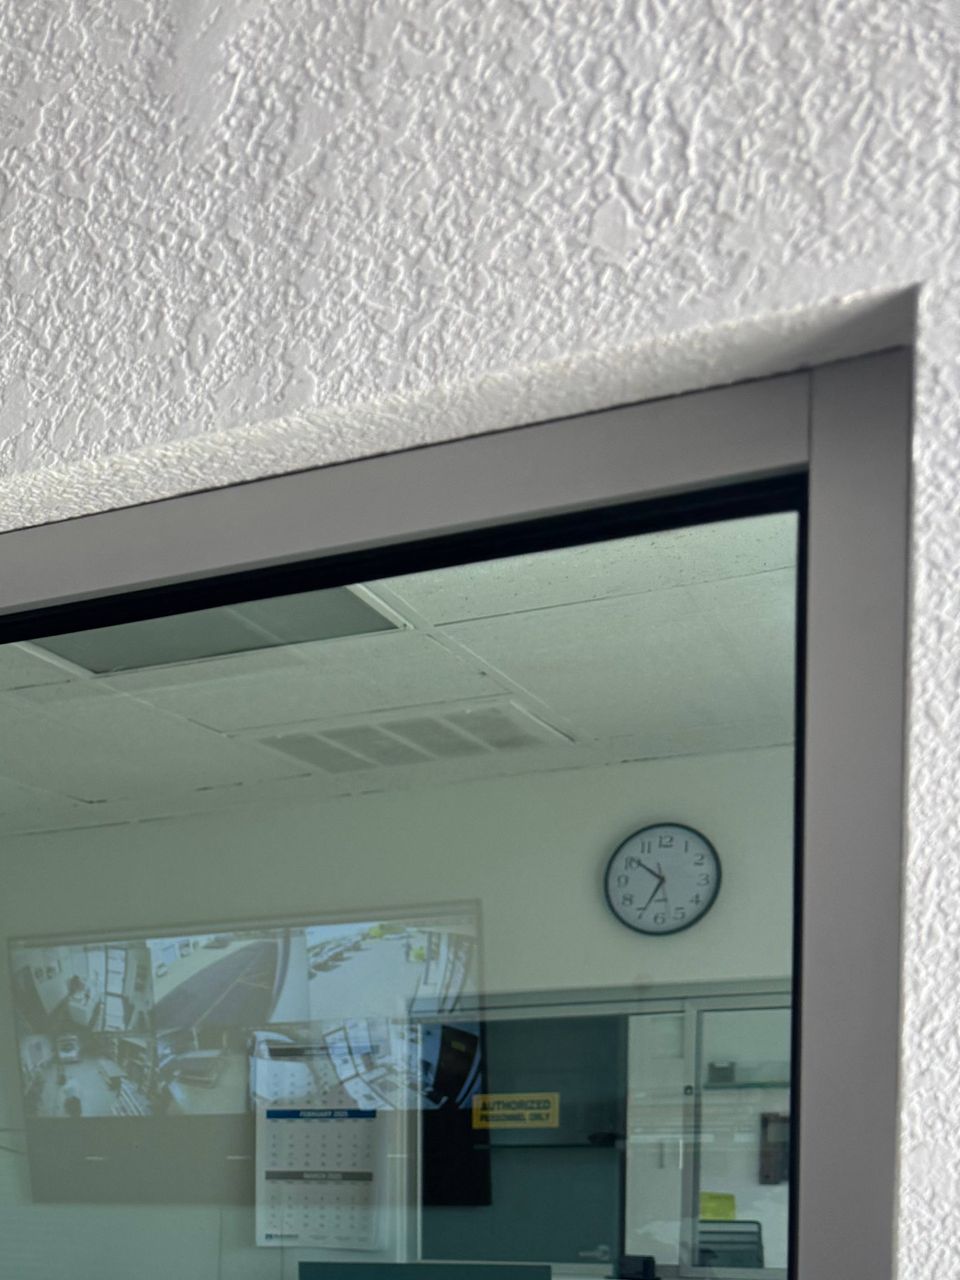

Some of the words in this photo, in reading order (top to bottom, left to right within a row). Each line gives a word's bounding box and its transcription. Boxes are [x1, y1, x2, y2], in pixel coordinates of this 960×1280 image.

[640, 841, 651, 854] 11
[658, 835, 674, 849] 12
[693, 853, 705, 866] 2
[653, 912, 666, 925] 6
